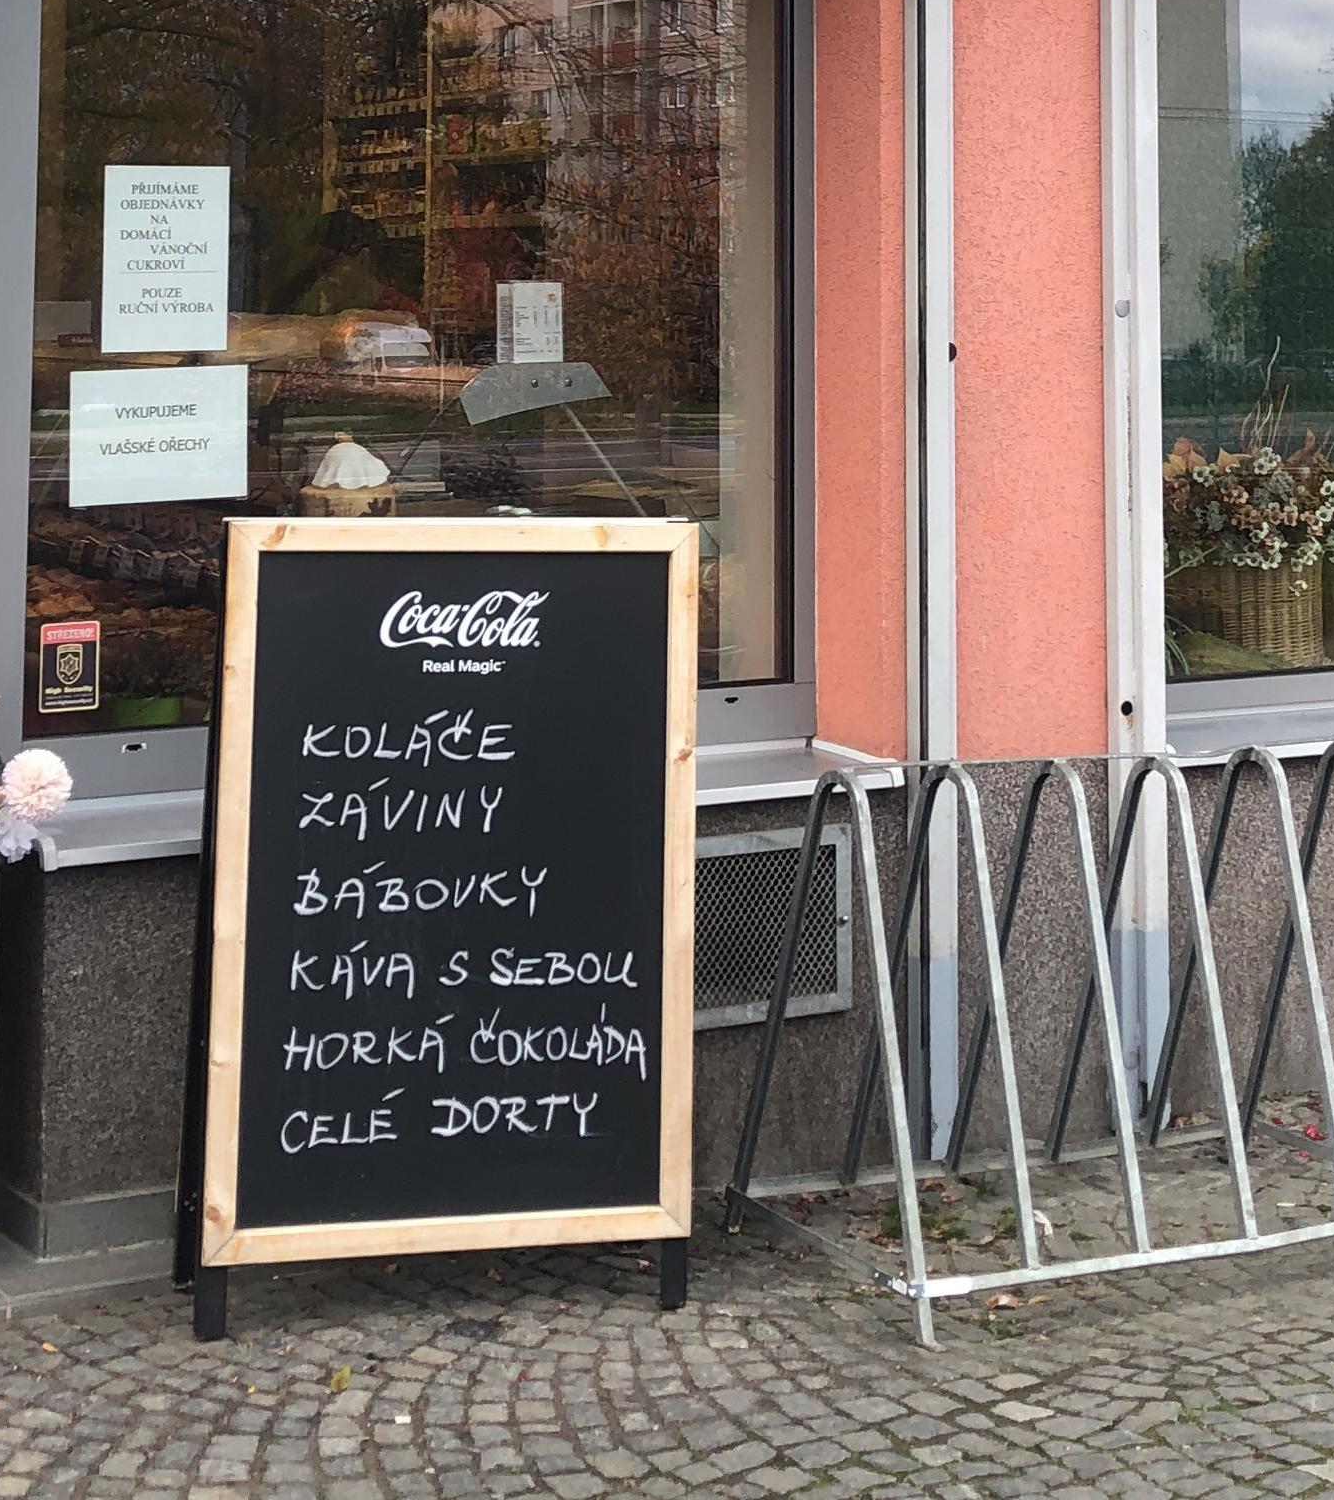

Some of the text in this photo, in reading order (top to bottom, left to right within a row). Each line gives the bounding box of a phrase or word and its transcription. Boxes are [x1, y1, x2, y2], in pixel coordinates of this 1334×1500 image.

[131, 180, 200, 195] PŘIJÍMÁME
[120, 196, 205, 210] OBJEDNÁVKY
[150, 214, 168, 225] NA
[120, 227, 172, 241] DOMÁCÍ
[150, 241, 208, 255] VÁNOČNÍ
[126, 256, 186, 271] CUKROVÍ
[141, 287, 183, 299] POUZE
[119, 300, 214, 315] RUČNÍ VÝROBA
[115, 403, 197, 420] VYKUPUJEME
[99, 436, 210, 456] VLAŠSKÉ OŘECHY
[379, 590, 550, 648] Coca-Cola
[422, 658, 455, 673] Real
[301, 707, 516, 767] KOLÁČE
[298, 776, 504, 841] ZÁVINY
[292, 860, 548, 919] BÁBOVKY
[290, 940, 638, 1000] KÁVA S SEBOU
[282, 1002, 647, 1081] HORKÁ ČOKOLÁDA
[280, 1087, 598, 1154] CELÉ DORTY
